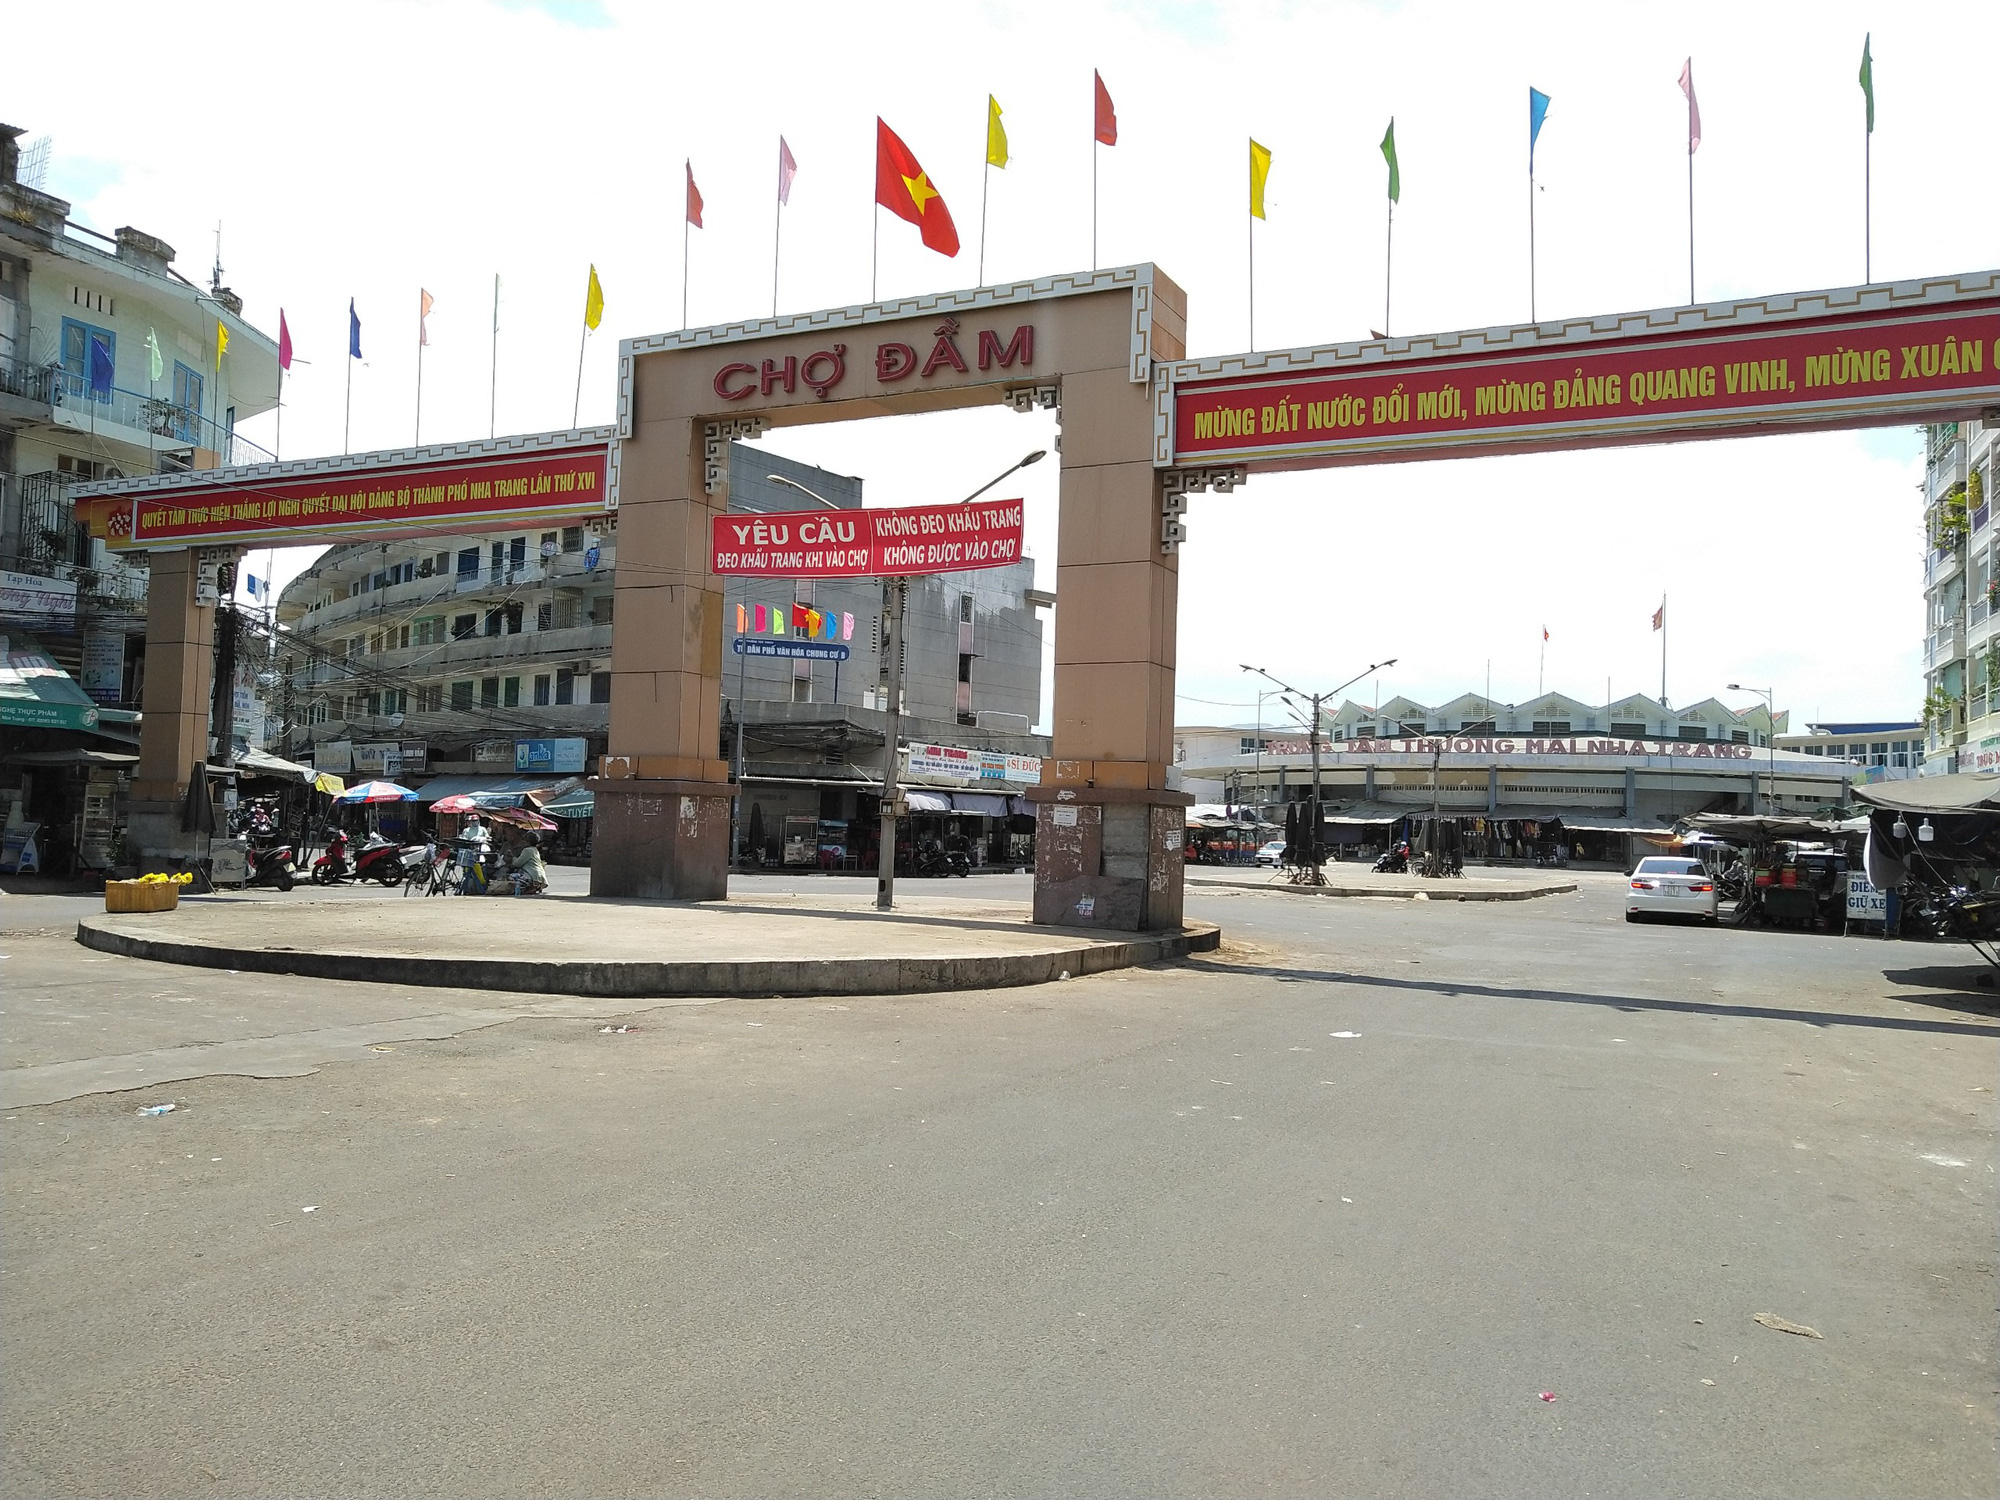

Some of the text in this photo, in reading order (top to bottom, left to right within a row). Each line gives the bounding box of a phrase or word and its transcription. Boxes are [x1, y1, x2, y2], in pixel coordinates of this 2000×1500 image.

[714, 317, 1035, 400] CHỢ ĐẦM
[1194, 405, 1255, 440] MỪNG
[1261, 394, 1301, 434] ĐẤT
[1307, 393, 1366, 430] NƯỚC
[1372, 382, 1410, 425] ĐỔI
[1417, 384, 1467, 422] MỚI,
[1475, 377, 1546, 416] MỪNG
[1553, 368, 1621, 410] ĐẢNG
[1629, 365, 1716, 406] QUANG
[1723, 358, 1796, 394] VINH,
[1804, 346, 1891, 388] MỪNG
[1900, 335, 1983, 379] XUÂN
[142, 506, 167, 529] QUYẾT
[188, 506, 208, 526] THỰC
[211, 502, 231, 524] HIỆN
[233, 498, 260, 520] THẮNG
[262, 500, 276, 520] LỢI
[279, 500, 299, 518] NGHỊ
[302, 491, 330, 515] QUYẾT
[333, 495, 348, 515] ĐẠI
[351, 490, 366, 513] HỘI
[369, 486, 394, 509] ĐẢNG
[397, 486, 409, 509] BỘ
[413, 483, 444, 504] THÀNH
[447, 477, 468, 501] PHỐ
[470, 481, 491, 499] NHA
[495, 478, 528, 497] TRANG
[531, 470, 550, 494] LẦN
[554, 469, 576, 491] THỨ
[577, 472, 595, 490] XVI
[733, 516, 856, 545] YÊU CẦU
[875, 506, 1020, 536] KHÔNG ĐEO KHẨU TRANG
[717, 545, 868, 570] ĐEO KHẨU TRANG KHI VÀO CHỢ
[883, 535, 1016, 566] KHÔNG ĐƯỢC VÀO CHỢ
[6, 573, 43, 586] Tạp Hóa
[747, 644, 760, 654] DÂN
[762, 644, 776, 654] PHỐ
[792, 647, 804, 657] HÓA
[806, 649, 828, 658] CHUNG
[841, 651, 846, 659] B
[1587, 740, 1648, 755] NHA
[1653, 741, 1752, 759] TRANG
[1022, 759, 1040, 772] ĐỨC
[1848, 895, 1886, 909] GIỮ XE
